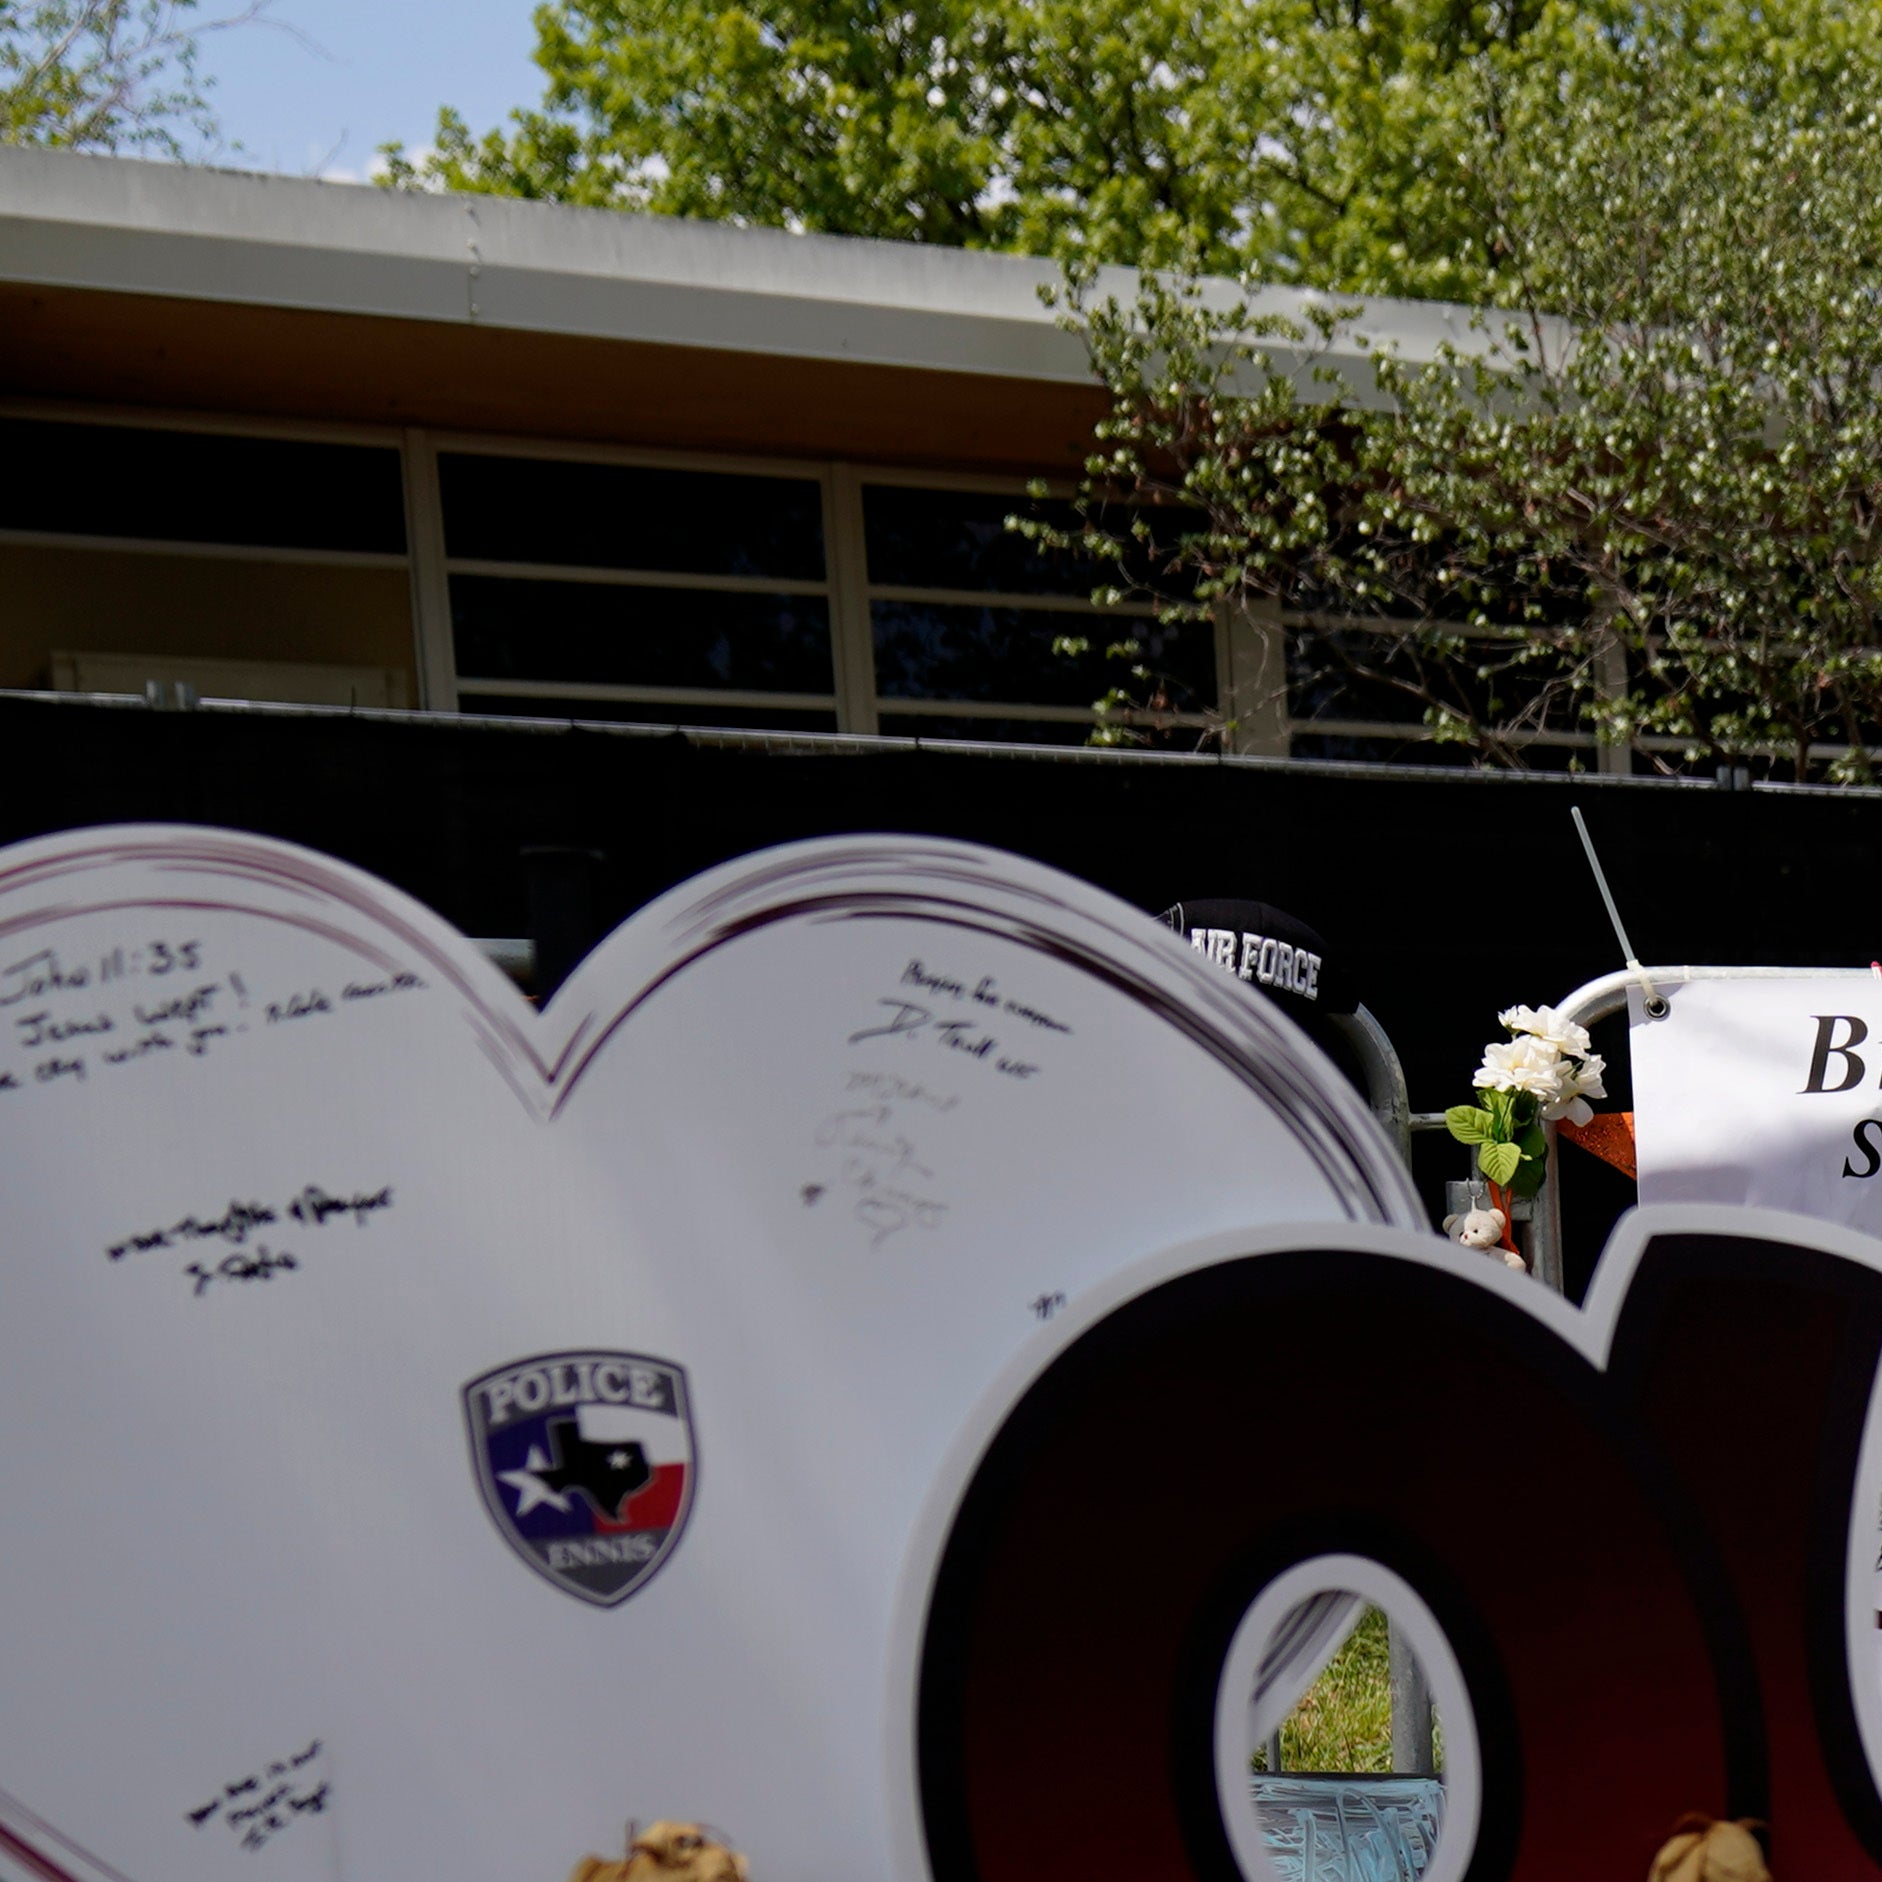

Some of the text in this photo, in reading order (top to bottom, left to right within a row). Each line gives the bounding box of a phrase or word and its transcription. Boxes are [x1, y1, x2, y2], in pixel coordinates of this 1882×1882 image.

[1189, 927, 1322, 1001] AIR FORCE
[487, 1361, 664, 1425] POLICE
[548, 1532, 657, 1571] ENNIS
